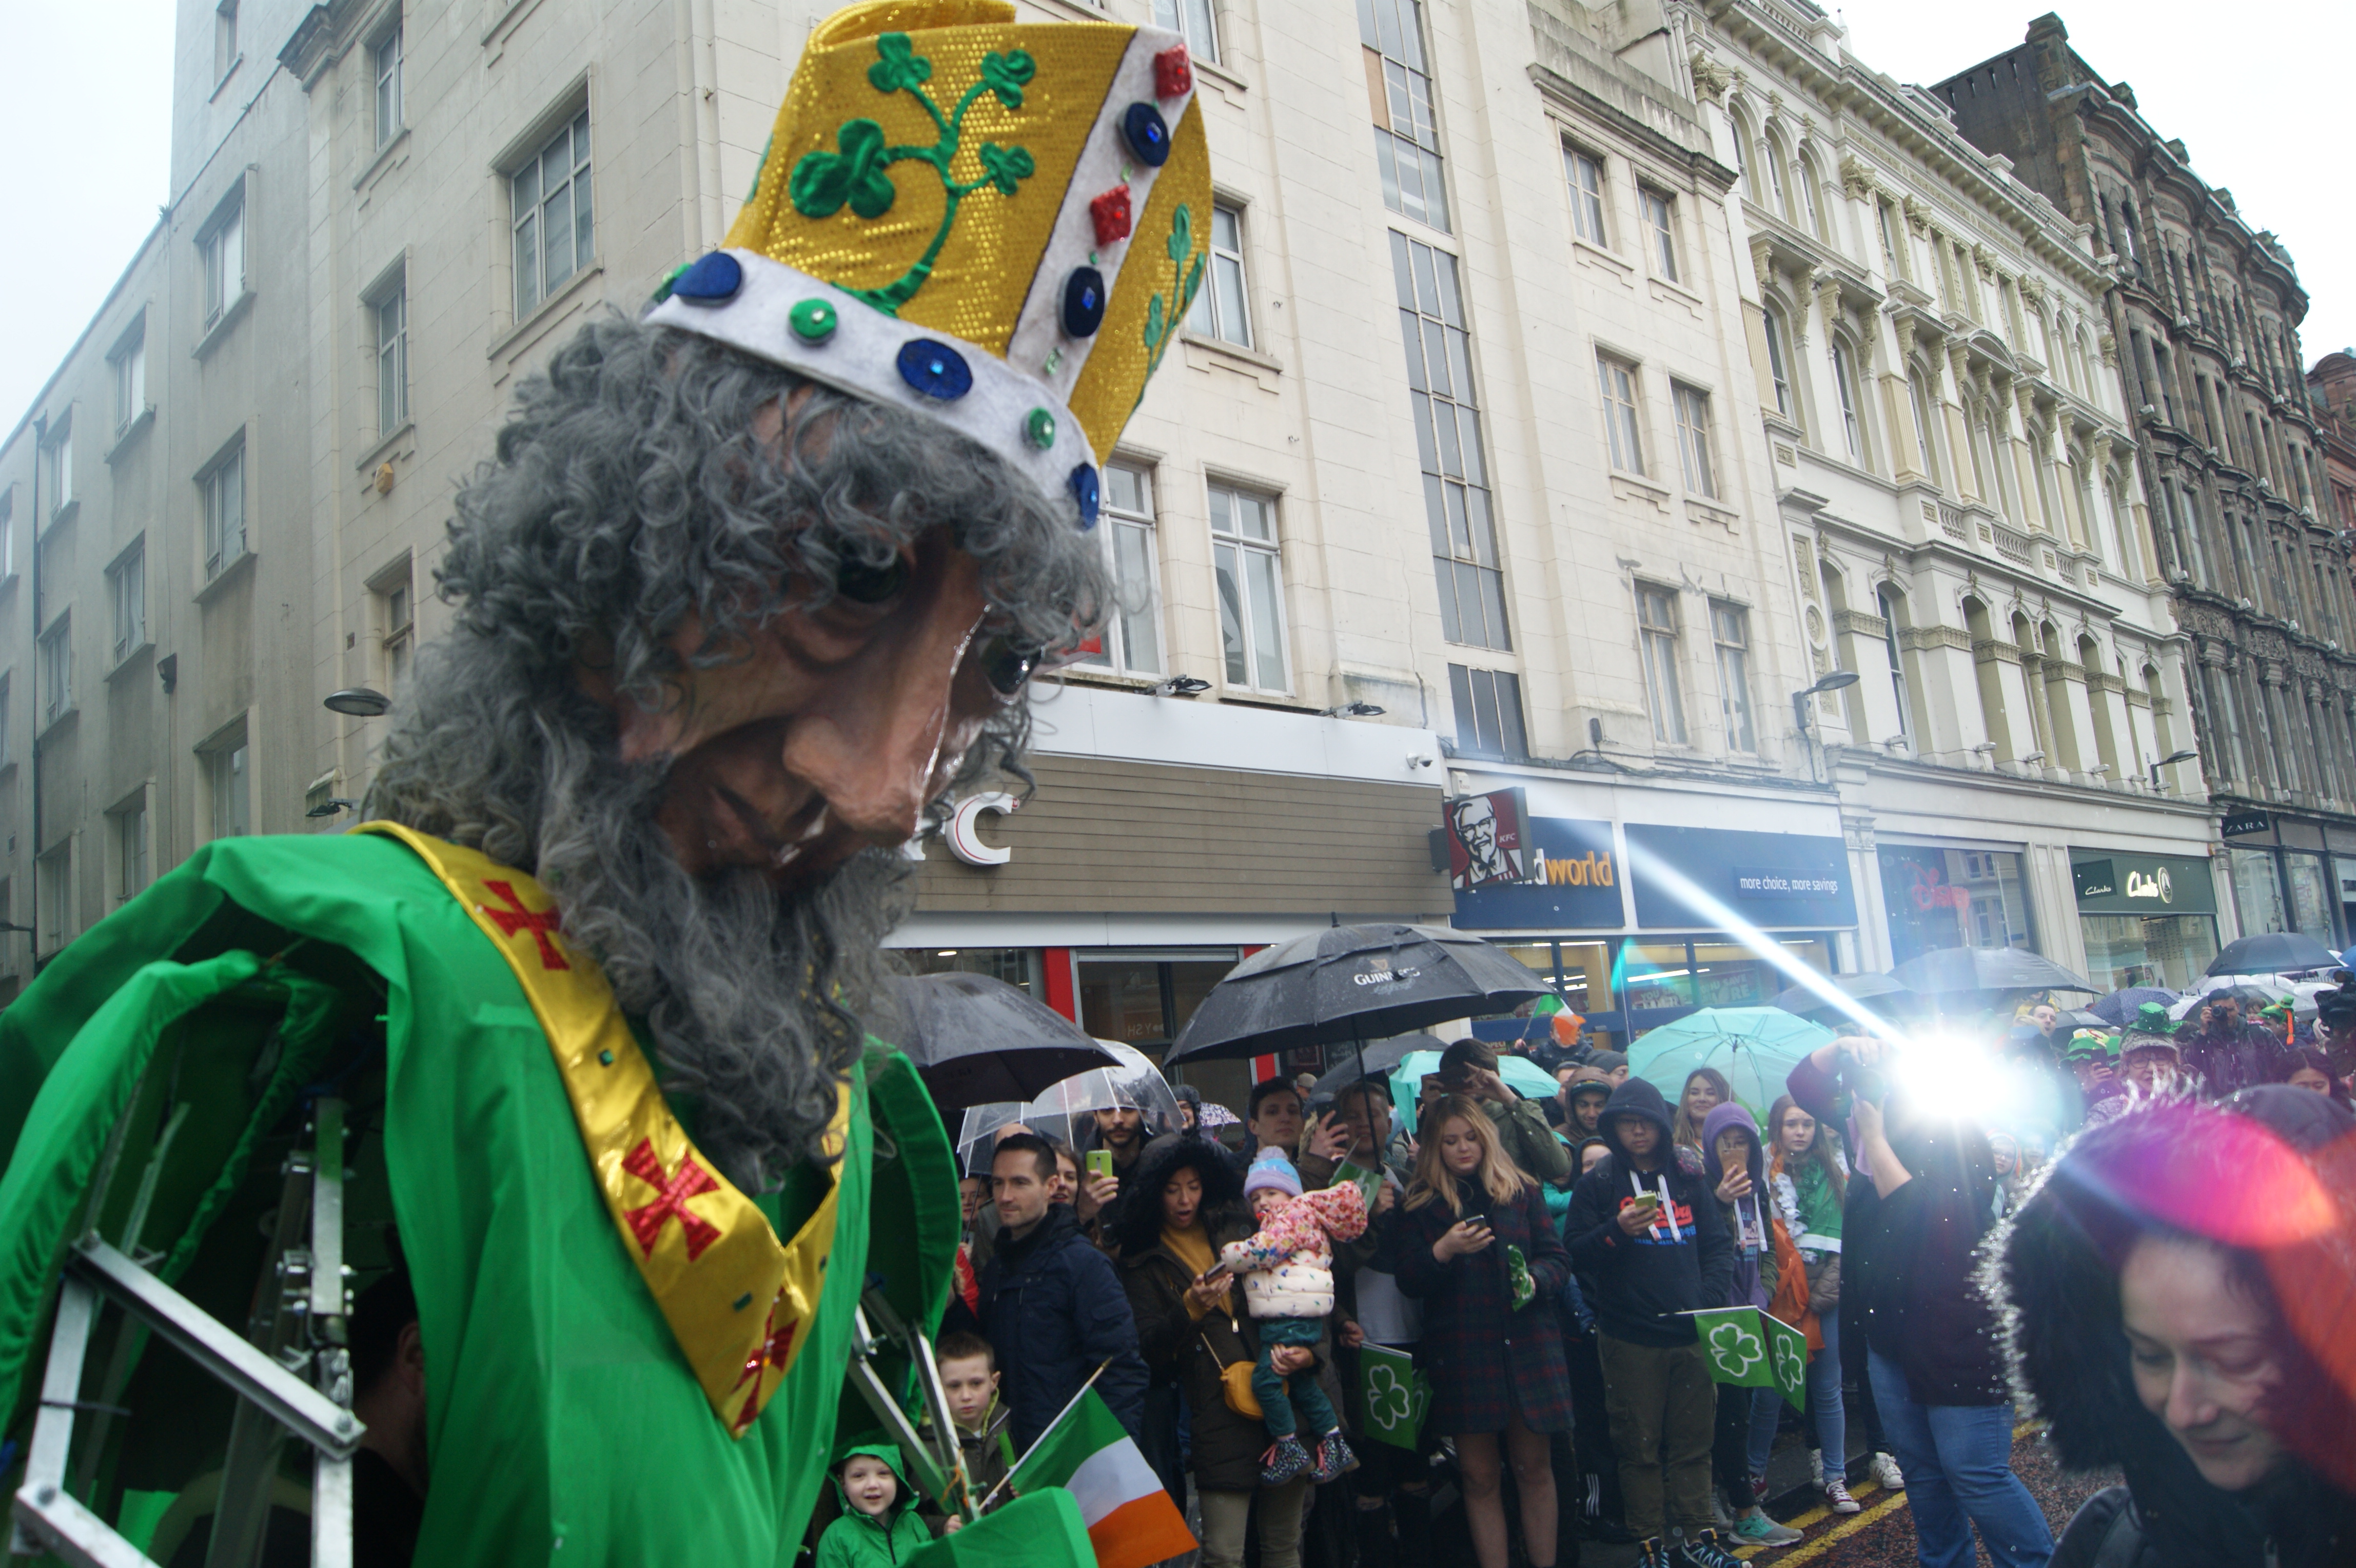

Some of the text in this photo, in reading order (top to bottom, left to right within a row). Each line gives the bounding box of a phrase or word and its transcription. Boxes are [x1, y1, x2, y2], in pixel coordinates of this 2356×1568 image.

[2226, 821, 2265, 832] ZARA
[1499, 833, 1516, 843] KFC
[1740, 875, 1838, 894] more choice, more savings
[2085, 885, 2112, 896] Clarks
